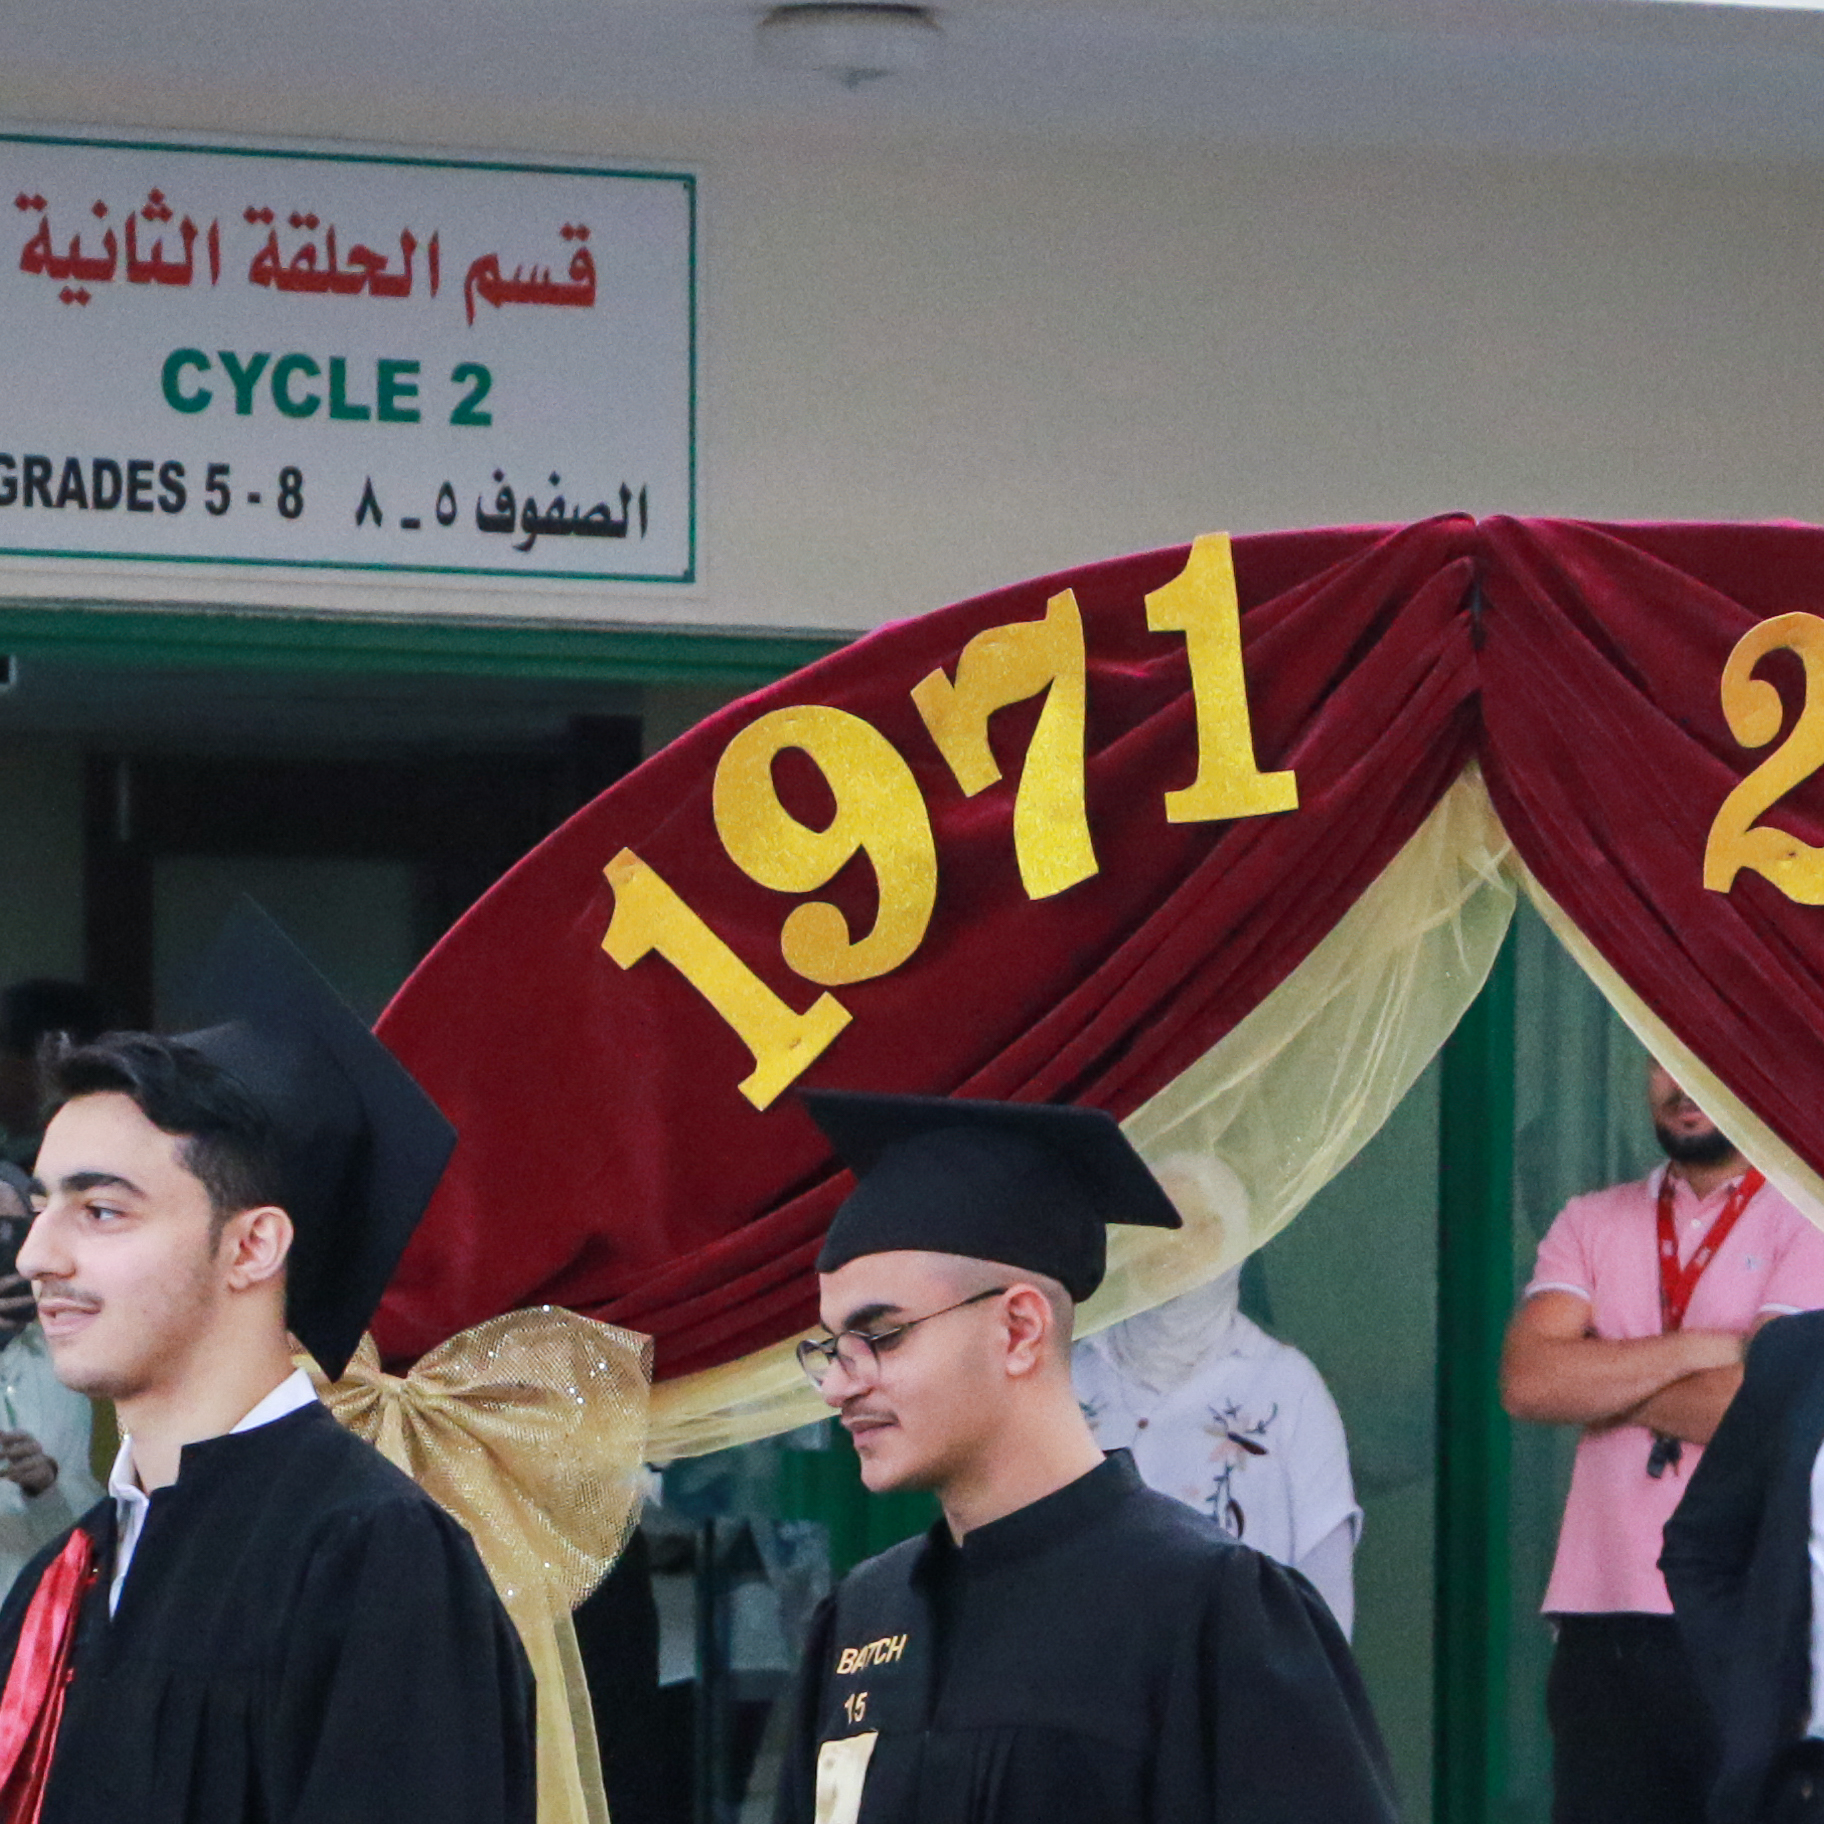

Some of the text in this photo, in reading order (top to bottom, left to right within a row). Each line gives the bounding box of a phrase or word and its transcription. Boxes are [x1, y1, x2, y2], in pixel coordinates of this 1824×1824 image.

[14, 188, 597, 325] قسم الحلقة الثانية
[161, 348, 494, 427] CYCLE 2
[204, 463, 232, 516] 5
[276, 467, 305, 520] 8
[354, 477, 383, 528] ٨
[435, 481, 457, 527] ٥
[474, 470, 649, 553] الصفوف
[601, 531, 1299, 1111] 1971
[836, 1633, 907, 1675] BATCH
[844, 1691, 868, 1725] 15
